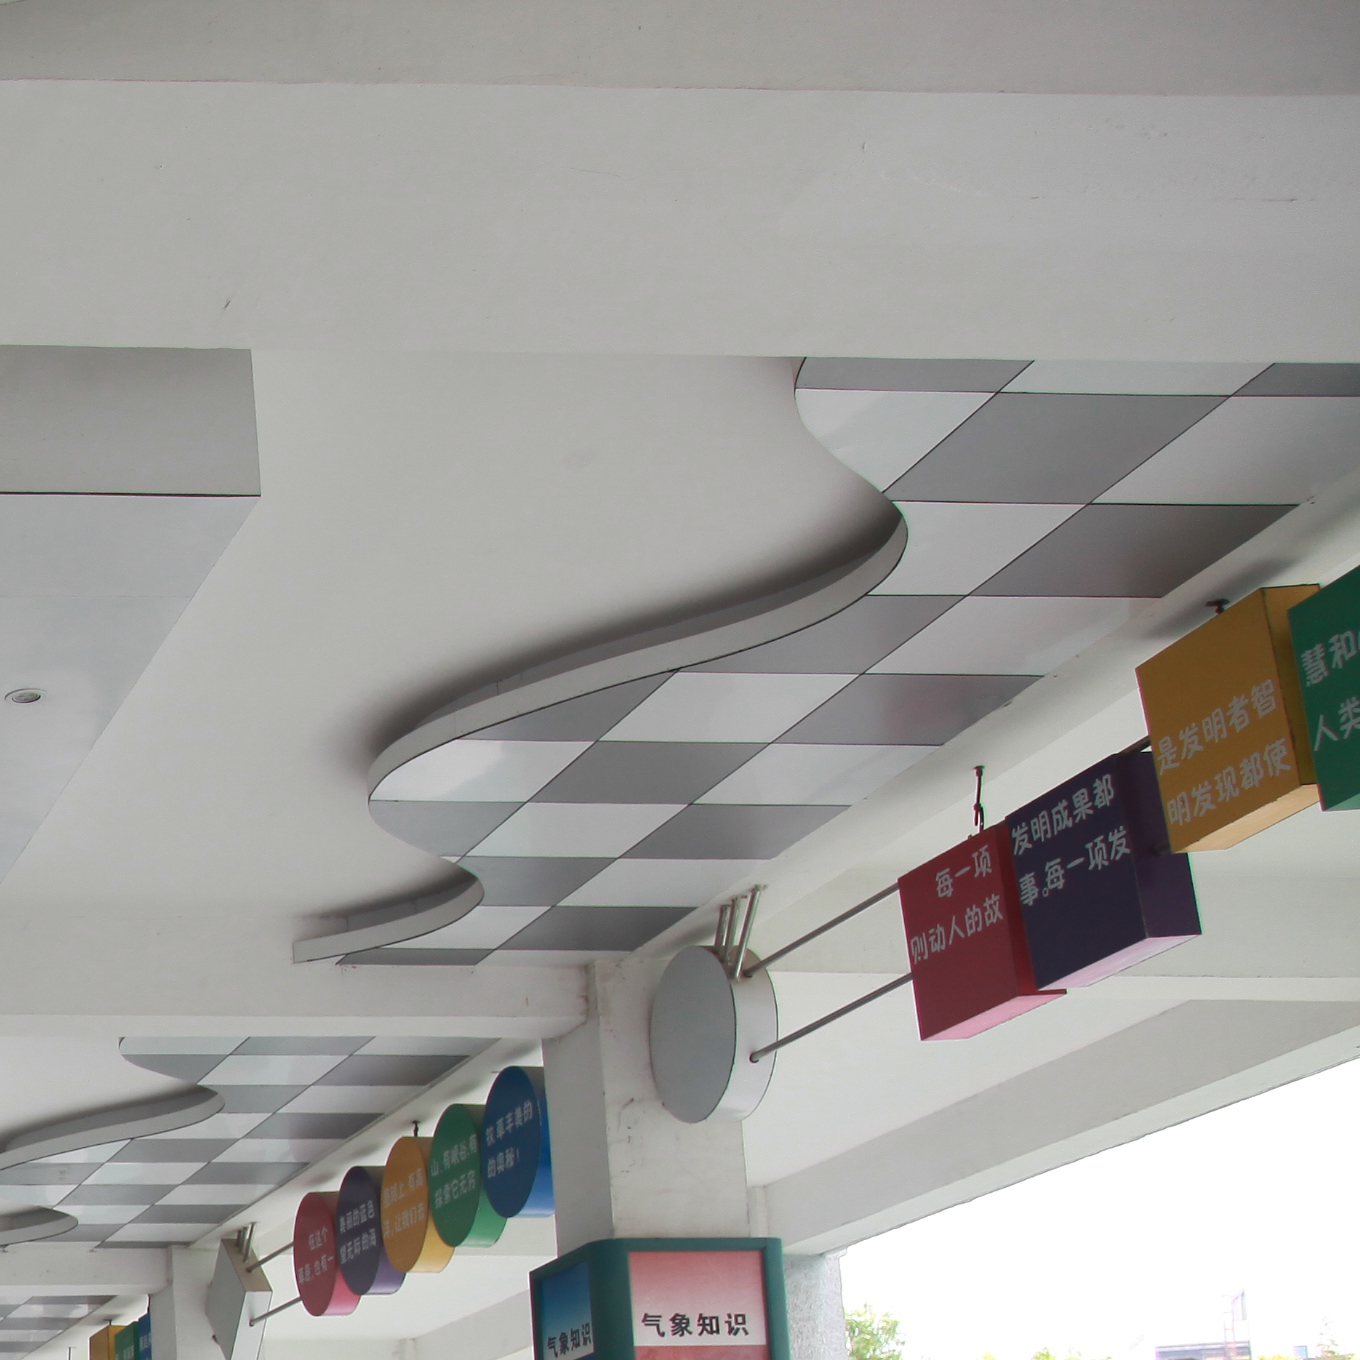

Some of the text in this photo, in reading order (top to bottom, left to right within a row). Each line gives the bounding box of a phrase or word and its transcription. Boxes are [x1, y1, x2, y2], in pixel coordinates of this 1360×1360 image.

[1300, 629, 1360, 687] 慧和
[1155, 679, 1277, 776] 是发明者智
[1167, 737, 1292, 827] 明发现都使
[1010, 773, 1115, 857] 发明成果都
[935, 844, 993, 900] 每一项
[910, 892, 1004, 964] 则动人的故
[546, 1322, 592, 1358] 气象知识
[641, 1313, 750, 1337] 气象知识
